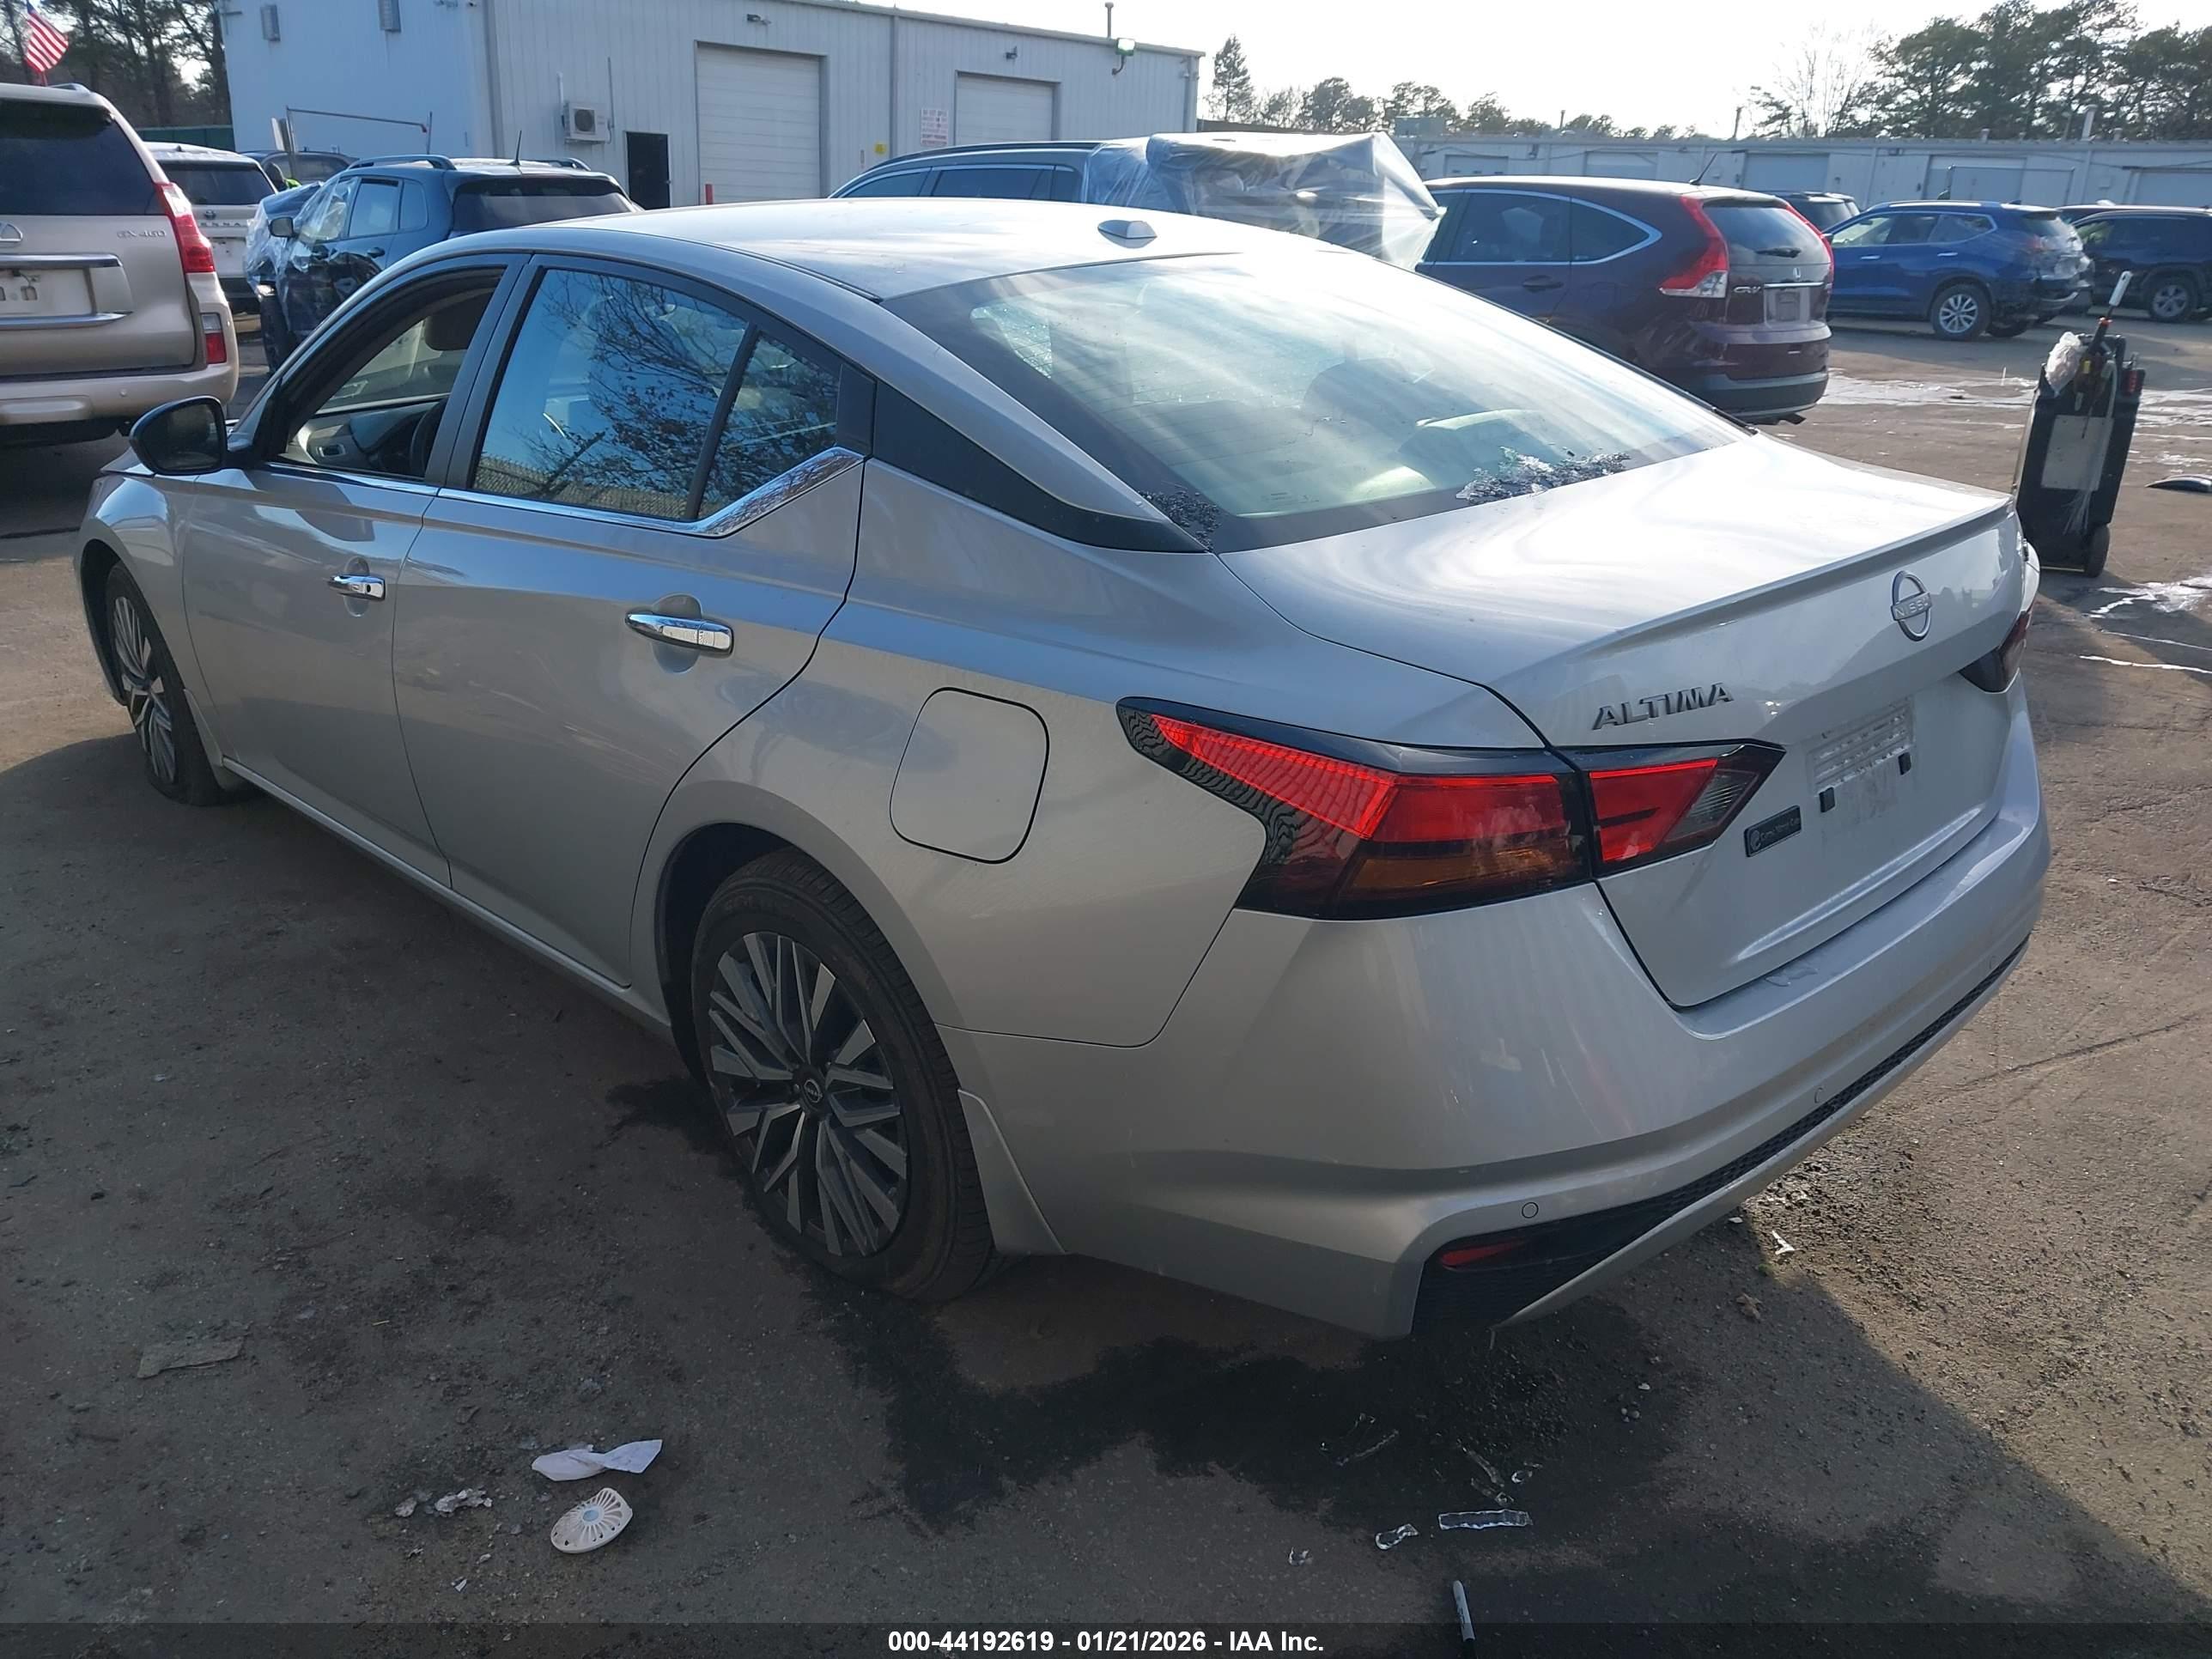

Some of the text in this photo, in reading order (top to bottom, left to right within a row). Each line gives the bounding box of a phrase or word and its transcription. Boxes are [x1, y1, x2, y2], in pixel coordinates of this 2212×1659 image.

[139, 229, 167, 239] 460
[1894, 596, 1931, 618] NISS
[1592, 682, 1735, 731] ALTIMA
